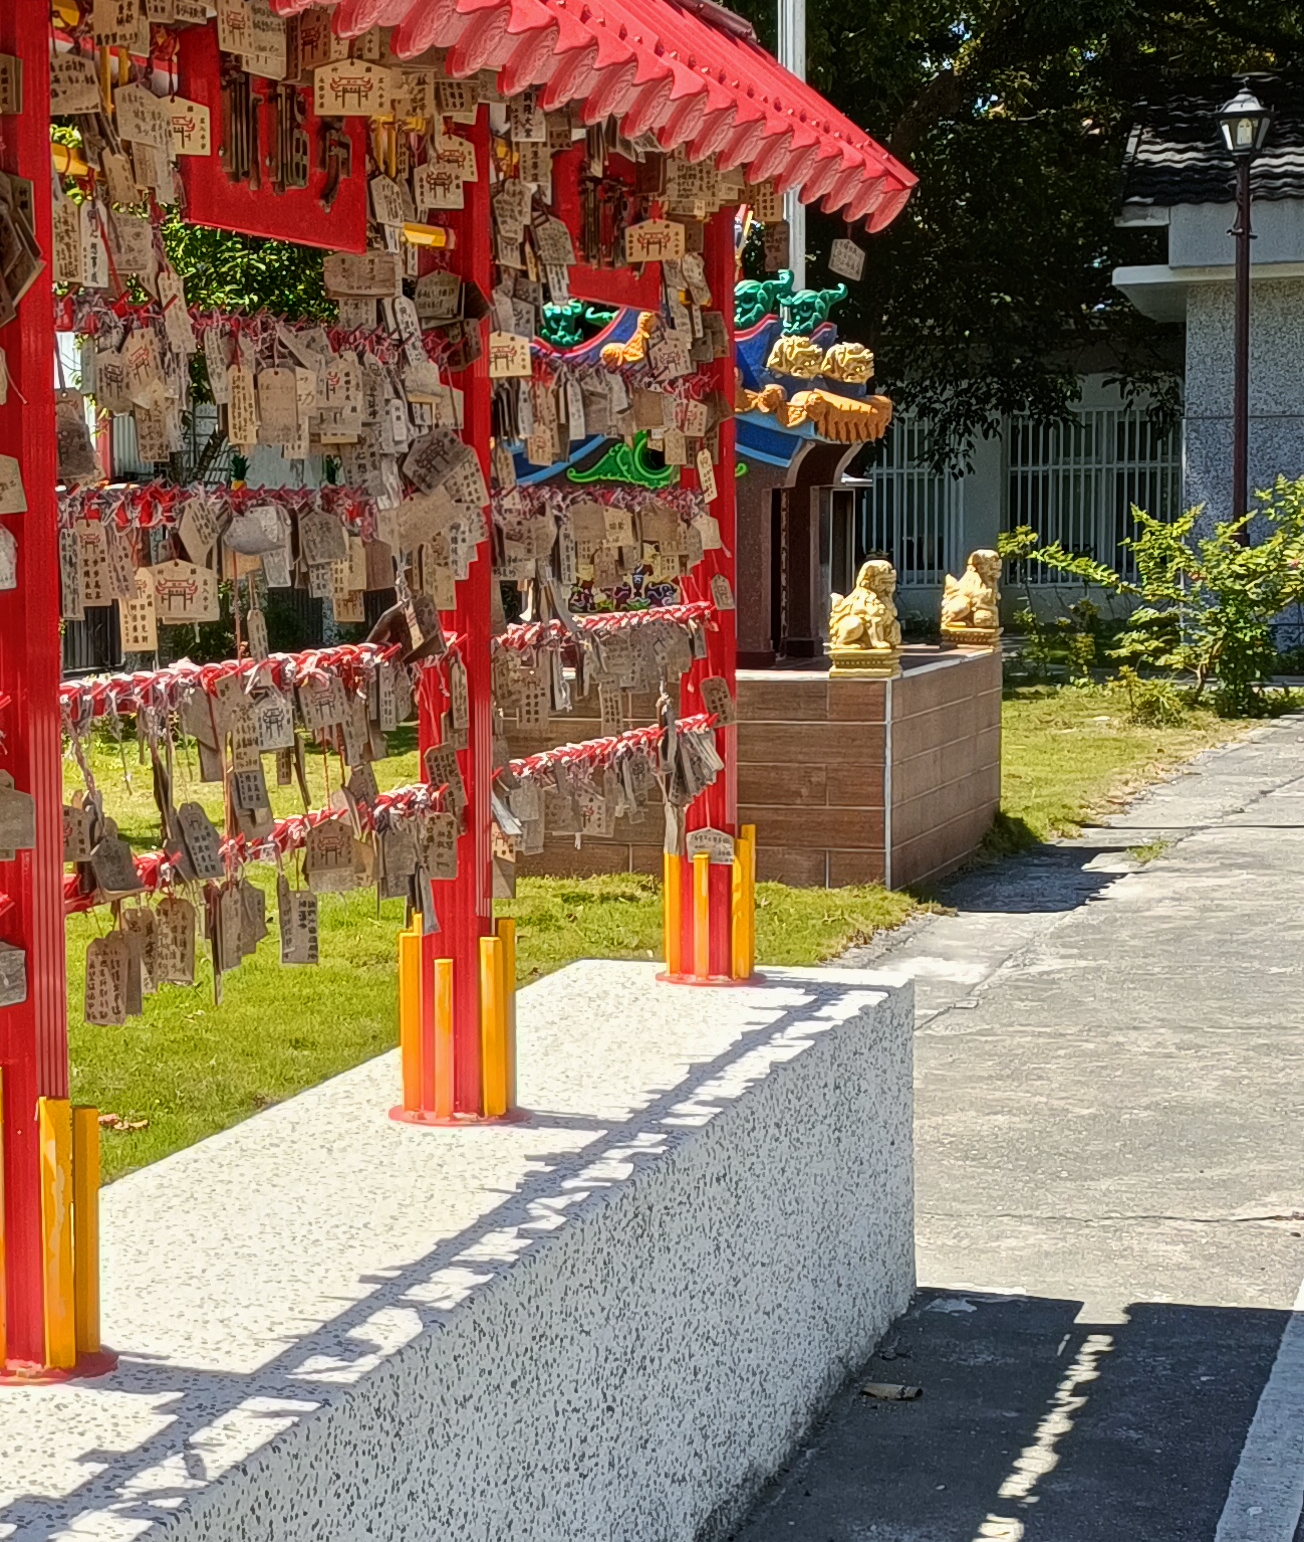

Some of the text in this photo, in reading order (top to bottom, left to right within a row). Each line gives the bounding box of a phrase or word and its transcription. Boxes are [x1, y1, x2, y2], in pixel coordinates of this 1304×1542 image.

[378, 76, 386, 108] 出入平安
[199, 117, 207, 150] 出入平安
[201, 578, 210, 612] 出入平安
